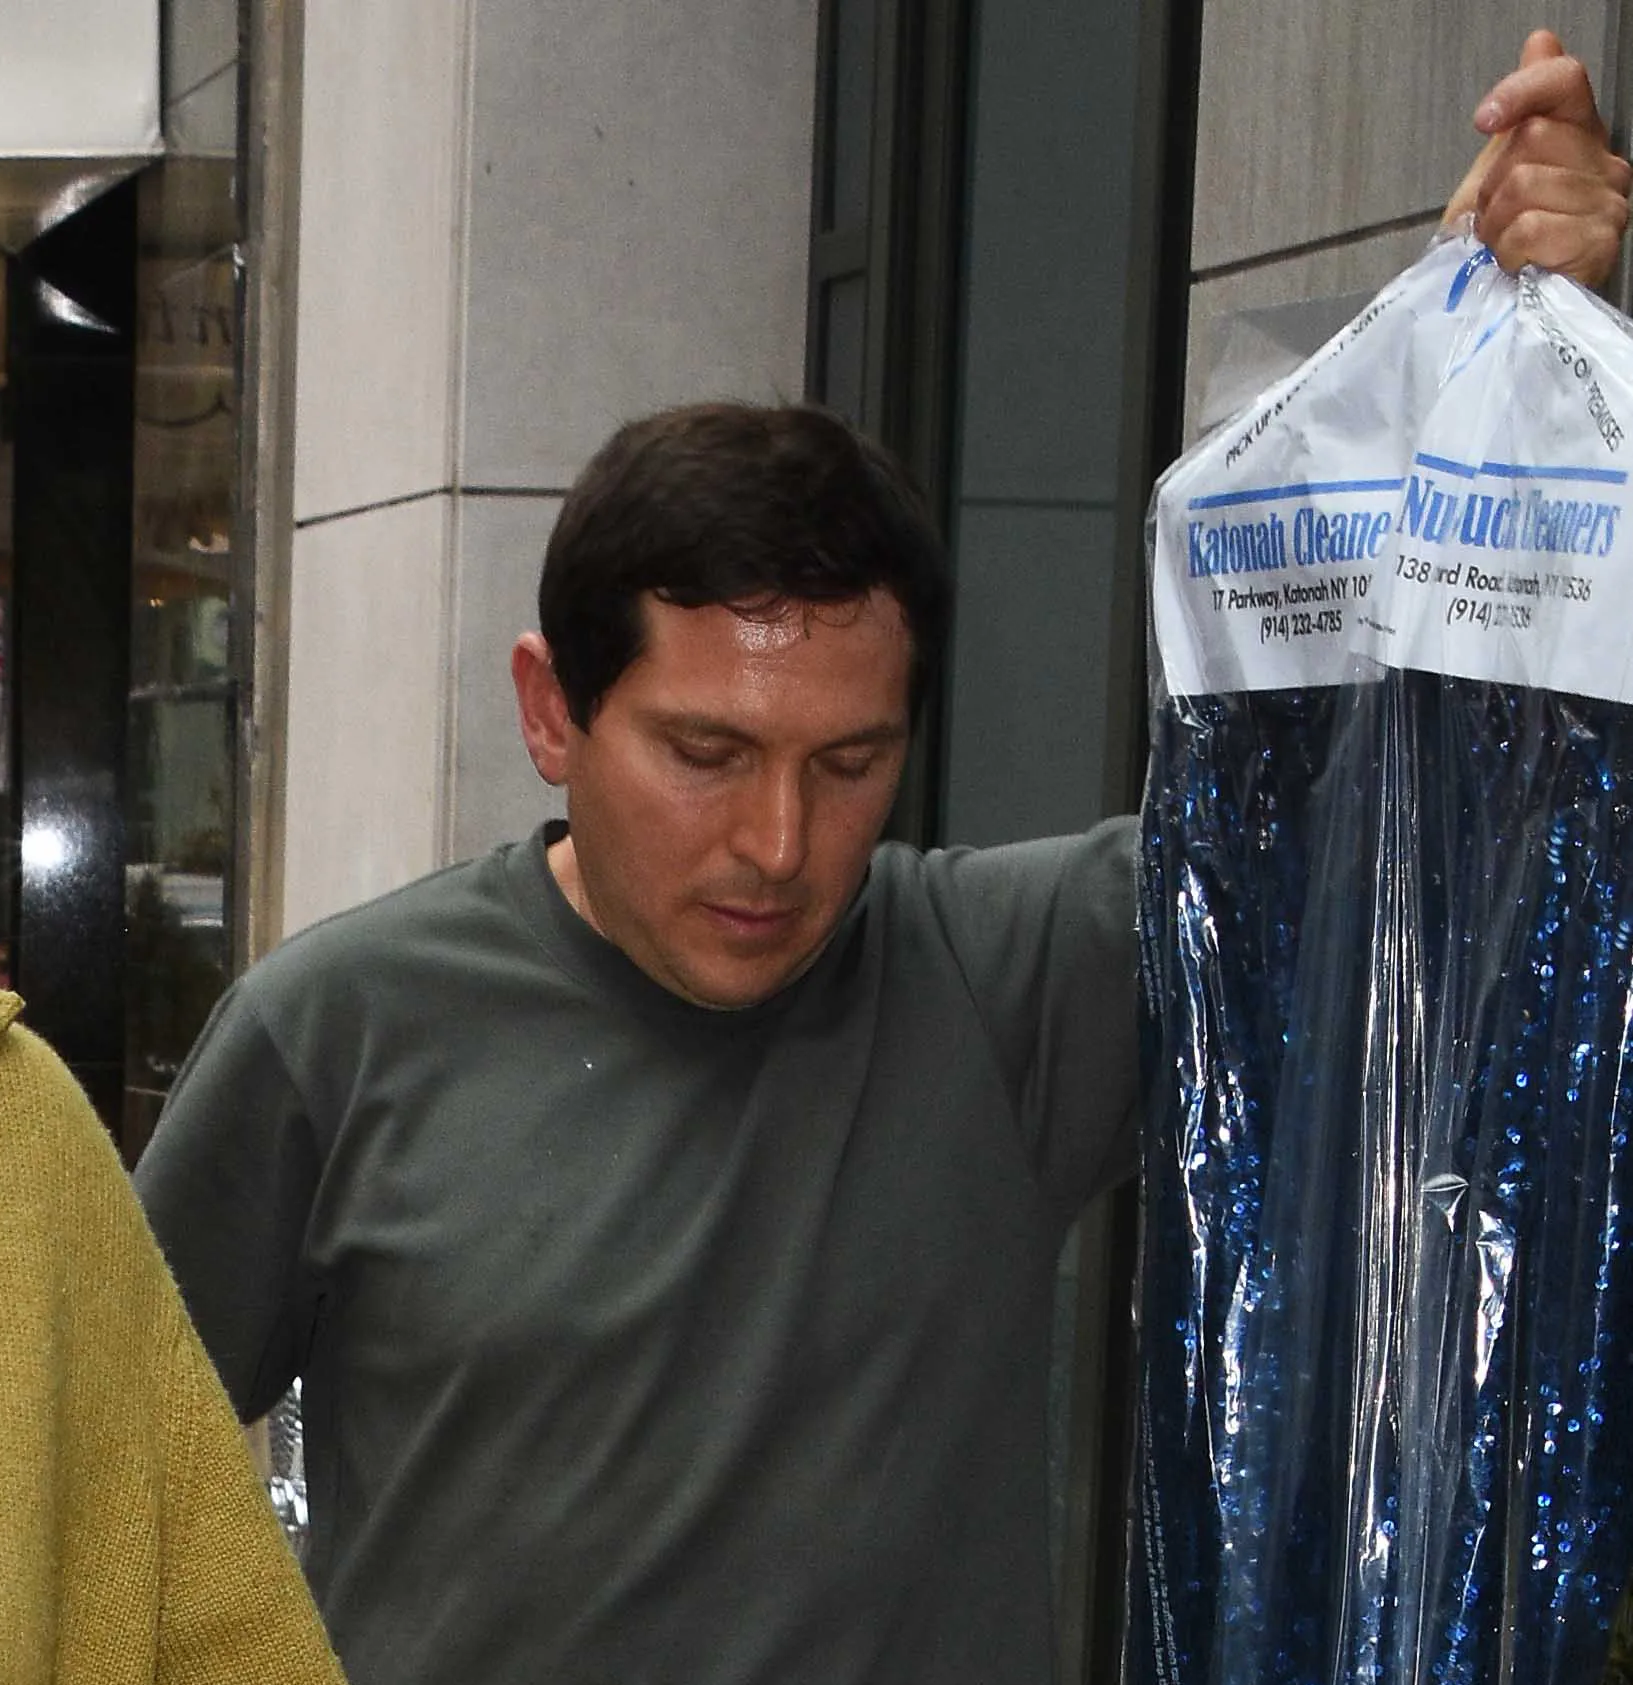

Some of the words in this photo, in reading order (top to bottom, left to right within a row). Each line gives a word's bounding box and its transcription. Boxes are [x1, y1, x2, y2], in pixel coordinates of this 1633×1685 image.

[1187, 511, 1288, 579] Katonah
[1395, 554, 1432, 584] 138
[1212, 590, 1224, 611] 17
[1227, 585, 1283, 613] Parkway,
[1282, 581, 1329, 605] Katonah
[1330, 577, 1348, 600] NY
[1352, 573, 1373, 598] 10
[1260, 614, 1290, 645] (914)
[1292, 609, 1343, 638] 232-4785
[1446, 597, 1493, 632] (914)
